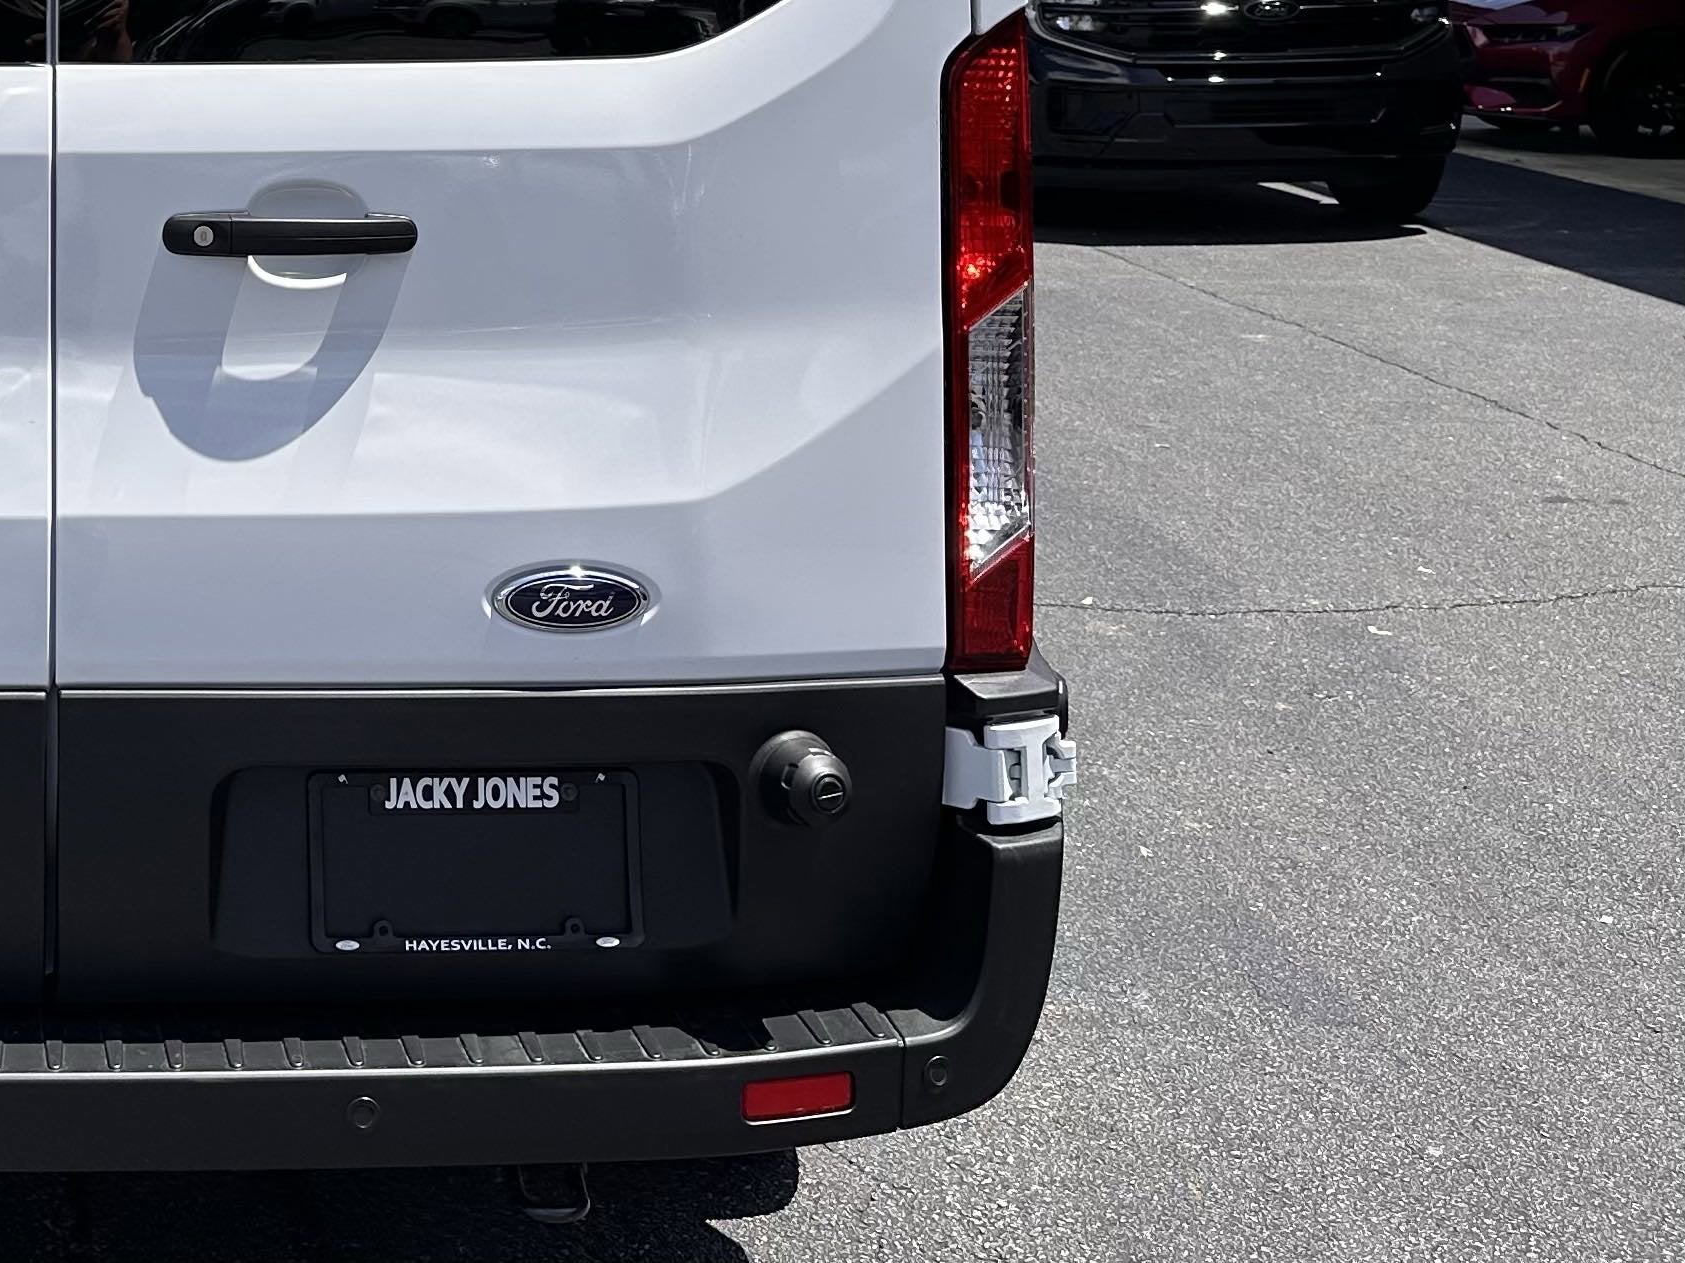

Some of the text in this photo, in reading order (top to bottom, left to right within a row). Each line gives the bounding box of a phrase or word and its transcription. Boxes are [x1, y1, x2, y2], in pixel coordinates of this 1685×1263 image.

[531, 583, 615, 618] Ford
[384, 776, 560, 810] JACKY JONES
[405, 938, 552, 952] HAYESVILLE, N.C.
